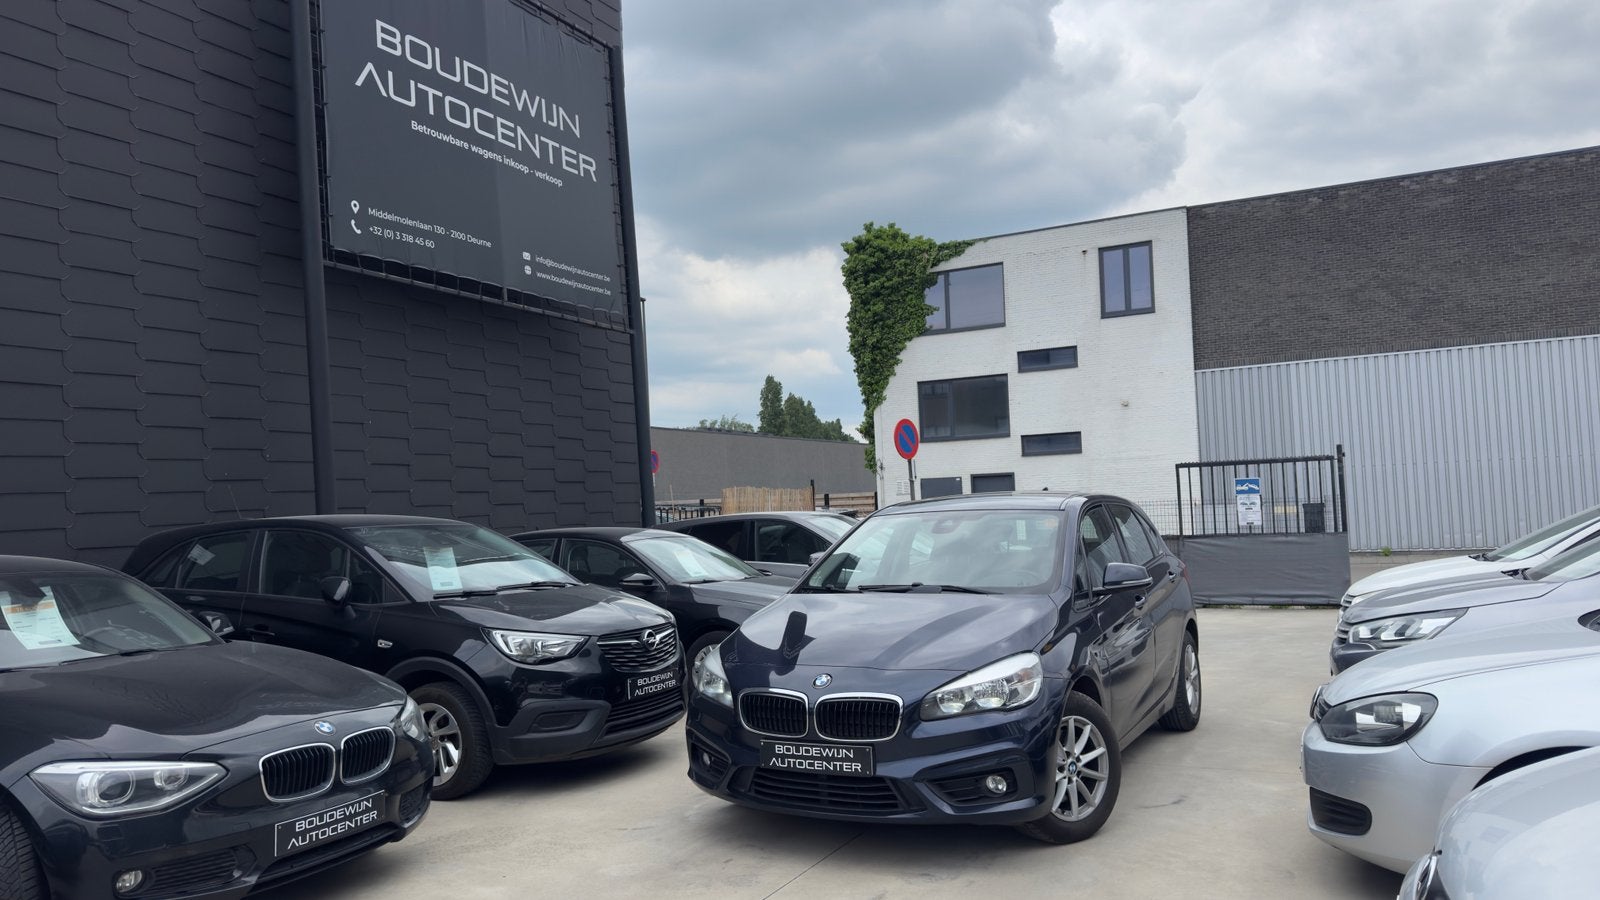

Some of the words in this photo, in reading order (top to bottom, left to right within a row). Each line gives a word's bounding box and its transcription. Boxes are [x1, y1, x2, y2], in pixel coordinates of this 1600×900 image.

[375, 18, 581, 139] BOUDEWIJN
[354, 61, 597, 183] AUTOCENTER
[410, 119, 470, 151] Betrouwbare
[470, 143, 503, 163] wagens
[503, 155, 530, 175] inkoop
[534, 168, 563, 188] verkoop
[368, 207, 433, 231] Middelmolenlaan
[433, 224, 446, 235] 130
[450, 229, 466, 241] 2100
[466, 234, 492, 248] Deurne
[369, 225, 383, 236] +32
[383, 228, 395, 240] (0)
[395, 231, 401, 240] 3
[401, 232, 414, 243] 318
[414, 236, 425, 246] 45
[425, 239, 435, 249] 60
[535, 255, 611, 282] info@boudewijnautocenter.be
[536, 271, 612, 296] www.boudewijnautocenter.be
[634, 679, 677, 697] AUTOCENTER
[769, 757, 862, 773] AUTOCENTER
[775, 744, 854, 759] BOUDEWIJN
[287, 810, 378, 850] AUTOCENTER
[295, 798, 373, 833] BOUDEWIJN
